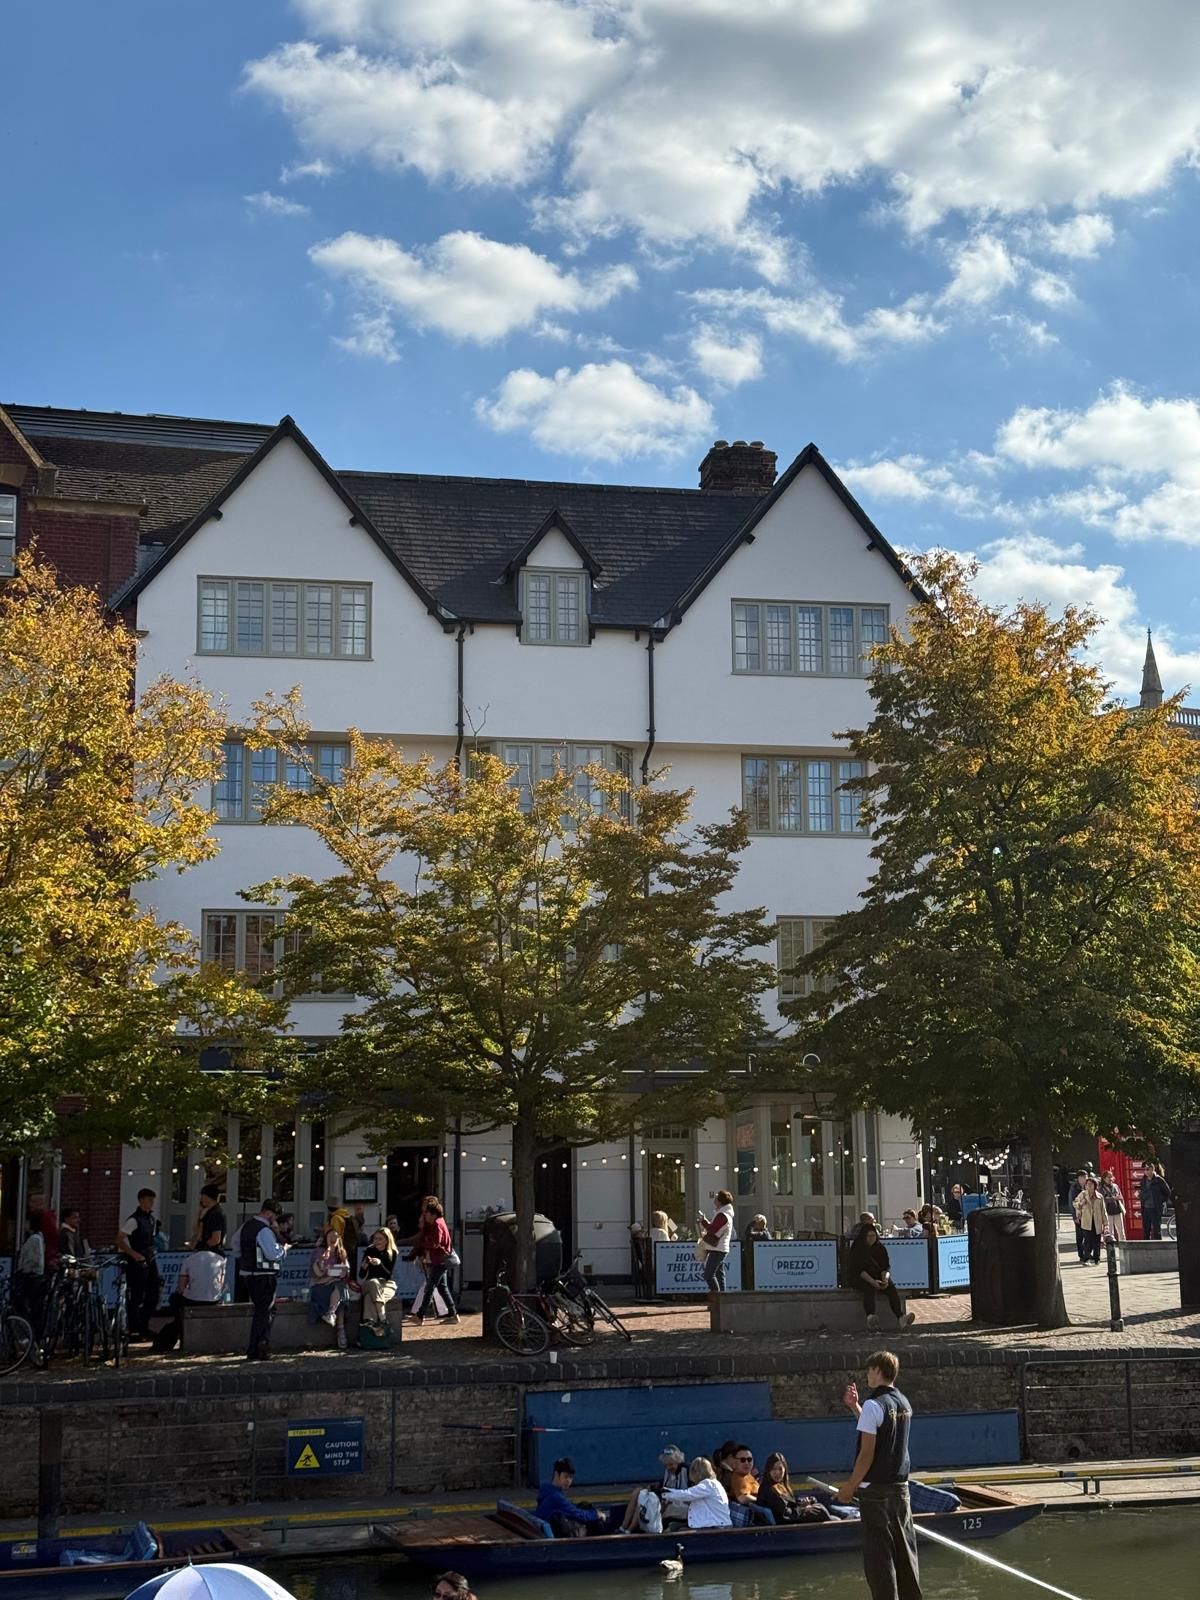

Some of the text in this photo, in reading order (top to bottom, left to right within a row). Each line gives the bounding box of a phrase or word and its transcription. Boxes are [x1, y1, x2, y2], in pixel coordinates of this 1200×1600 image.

[667, 1263, 687, 1272] THE
[777, 1260, 815, 1270] PREZZO
[324, 1441, 359, 1449] CAUTION!
[962, 1517, 982, 1530] 125
